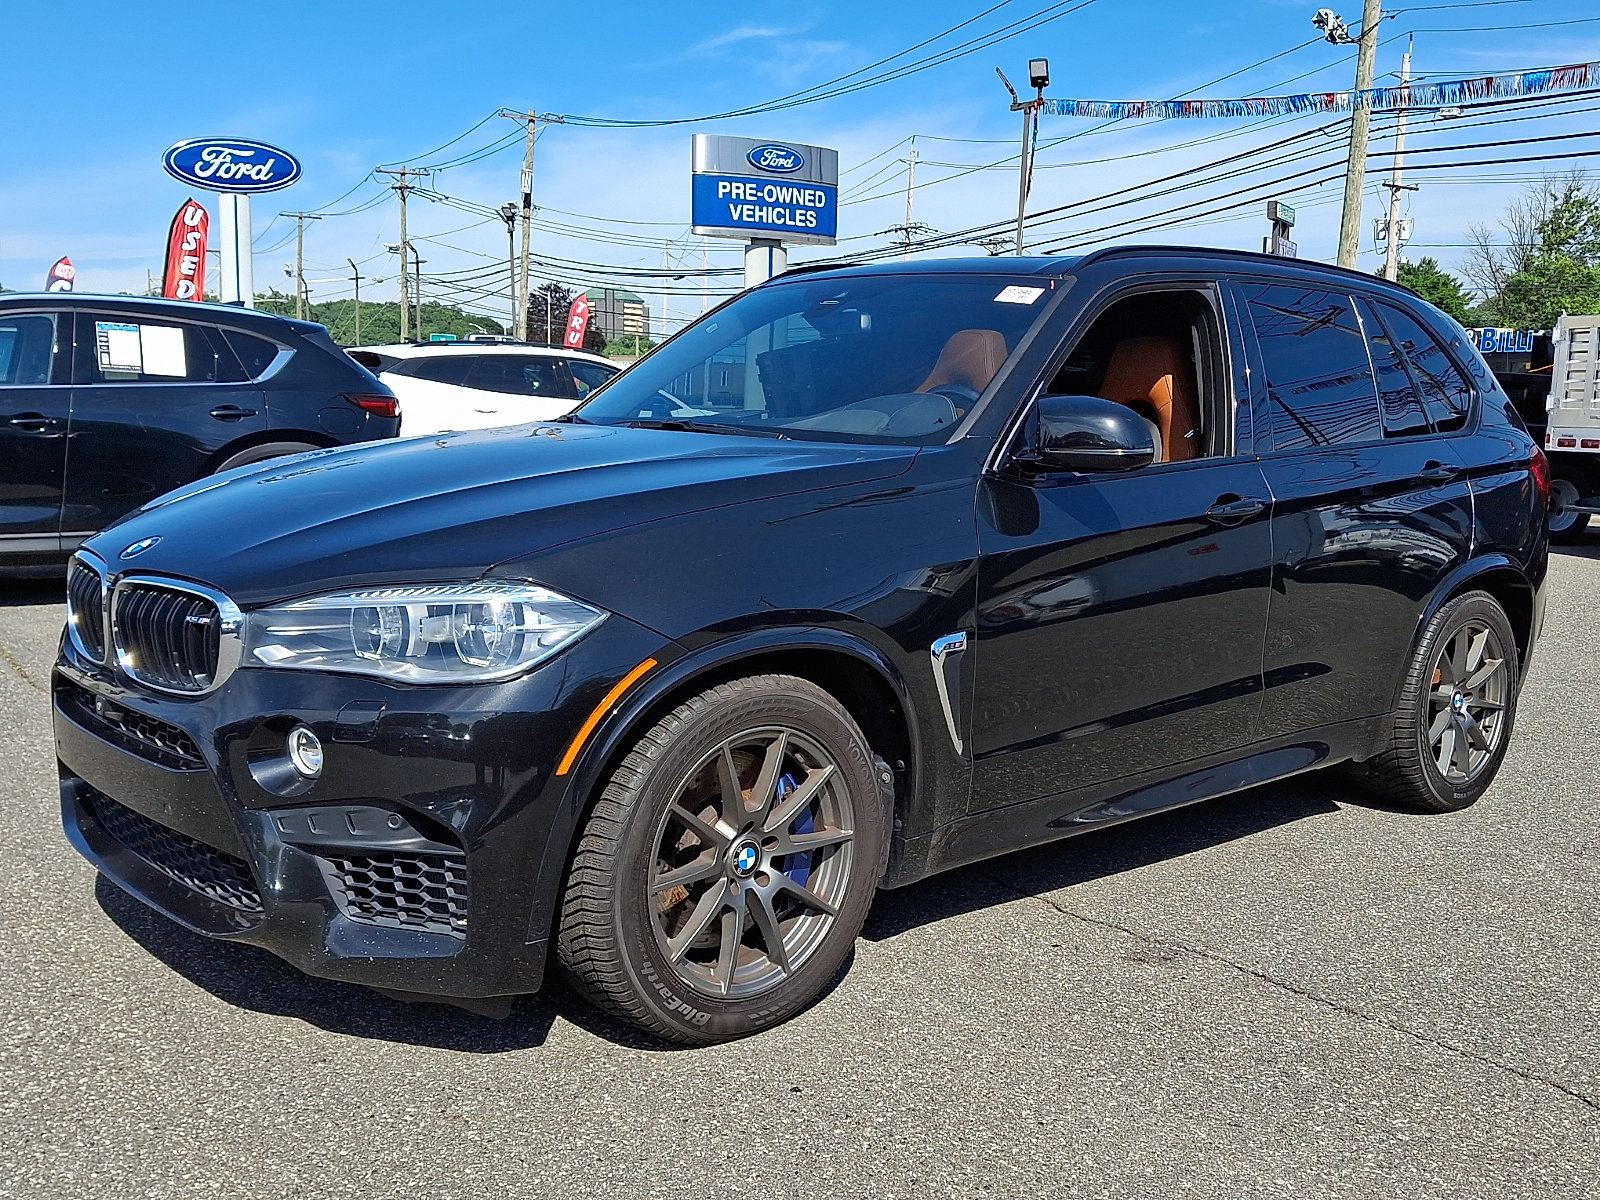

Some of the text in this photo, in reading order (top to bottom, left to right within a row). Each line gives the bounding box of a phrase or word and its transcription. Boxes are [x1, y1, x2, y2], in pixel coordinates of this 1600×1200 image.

[194, 146, 275, 181] Ford
[760, 148, 794, 168] Ford
[717, 181, 826, 208] PRE-OWNED
[728, 203, 818, 228] VEHICLES
[176, 205, 204, 299] USED
[641, 960, 712, 1026] BluEarth
